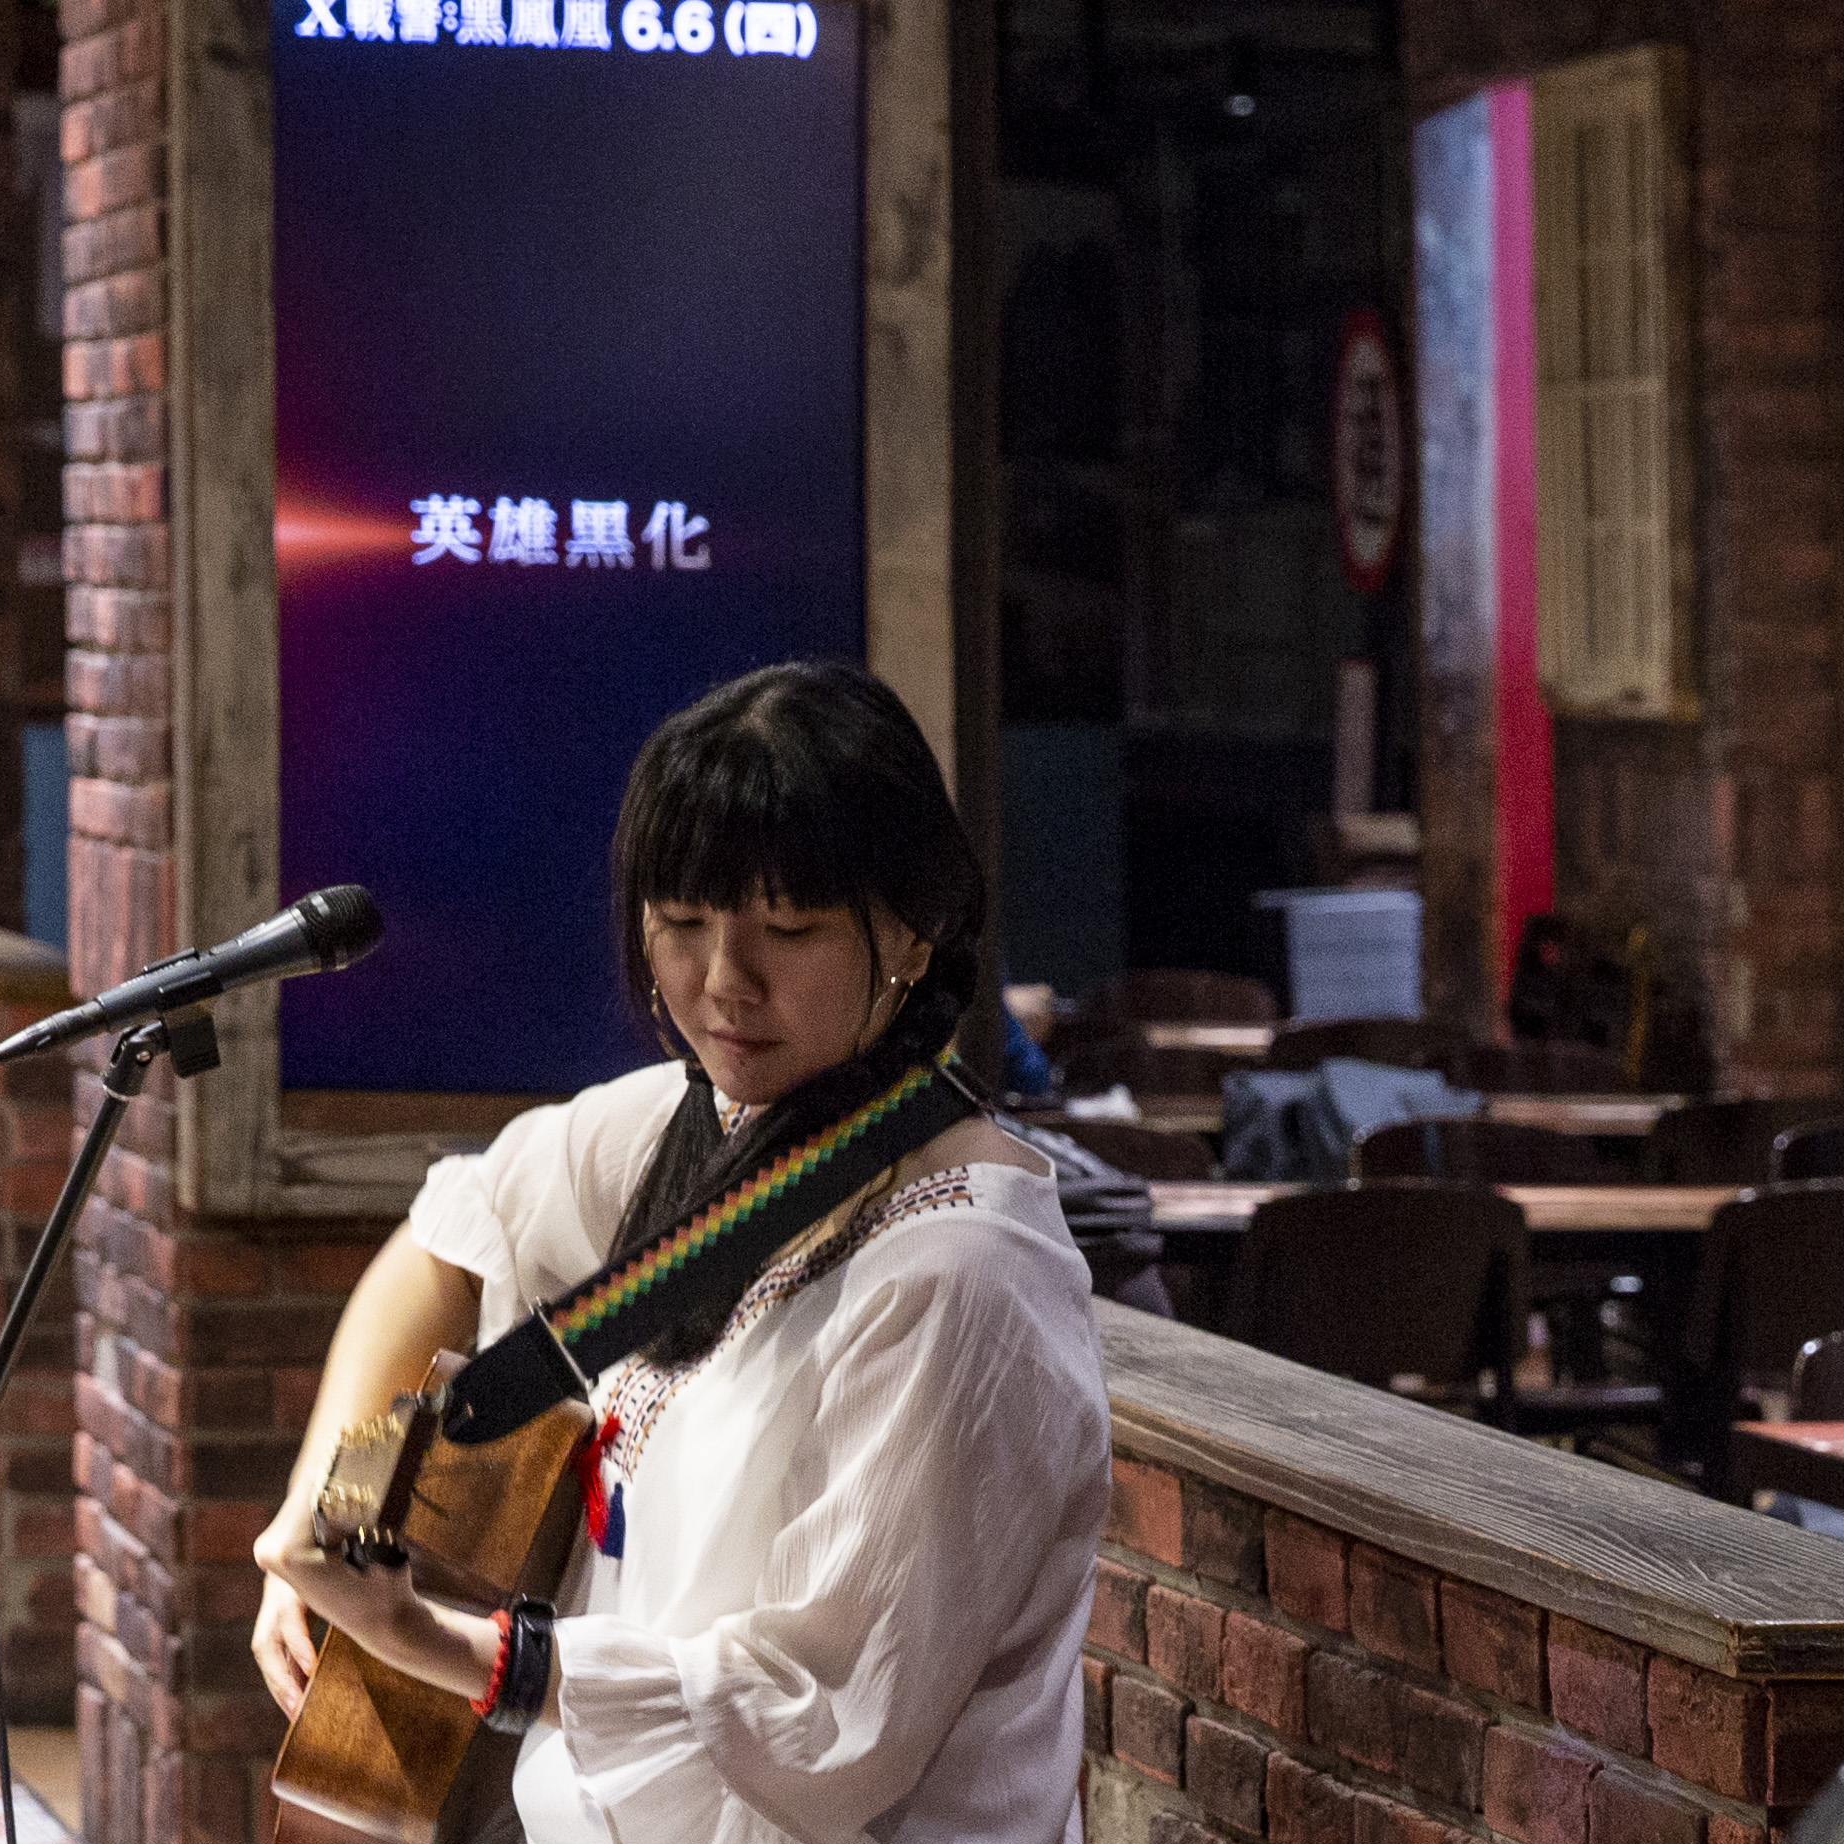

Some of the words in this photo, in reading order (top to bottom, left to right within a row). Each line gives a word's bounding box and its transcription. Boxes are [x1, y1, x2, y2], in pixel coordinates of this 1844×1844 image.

[621, 0, 716, 54] 6.6
[723, 0, 818, 59] (四)
[410, 493, 711, 570] 英雄黑化
